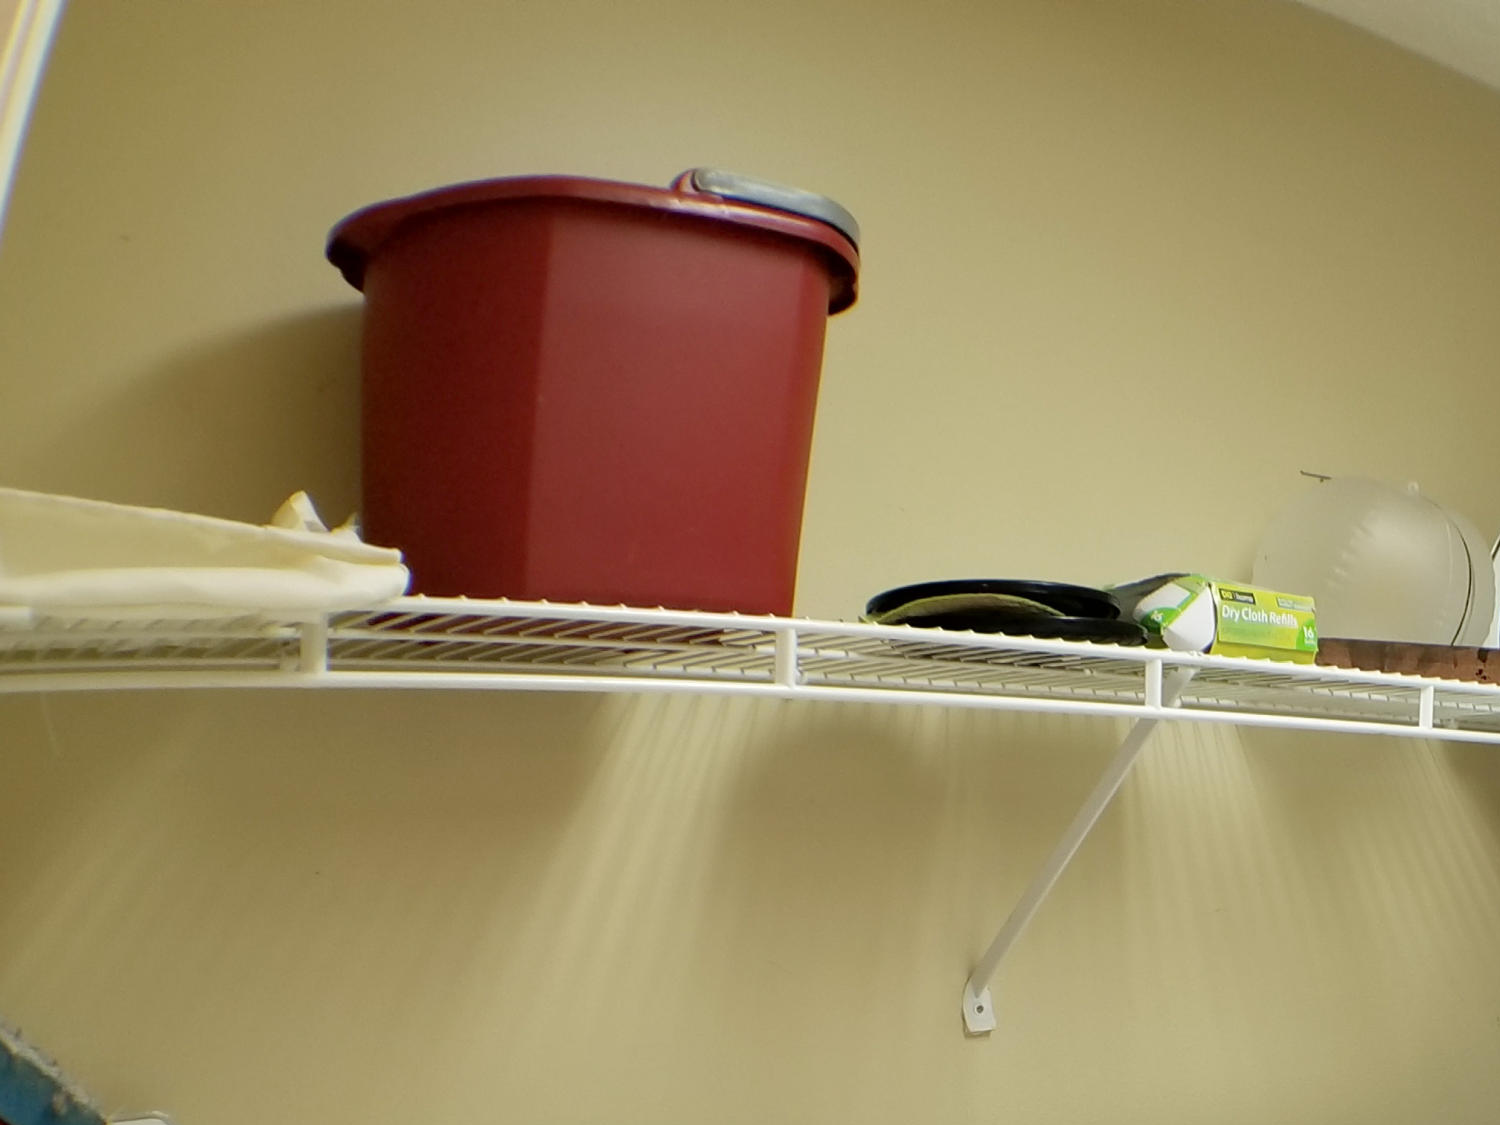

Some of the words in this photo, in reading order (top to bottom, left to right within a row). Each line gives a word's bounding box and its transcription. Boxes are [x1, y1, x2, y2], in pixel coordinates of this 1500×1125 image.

[1222, 605, 1240, 623] Dry
[1241, 606, 1268, 623] Cloth
[1269, 610, 1298, 628] Refills
[1303, 625, 1315, 640] 16
